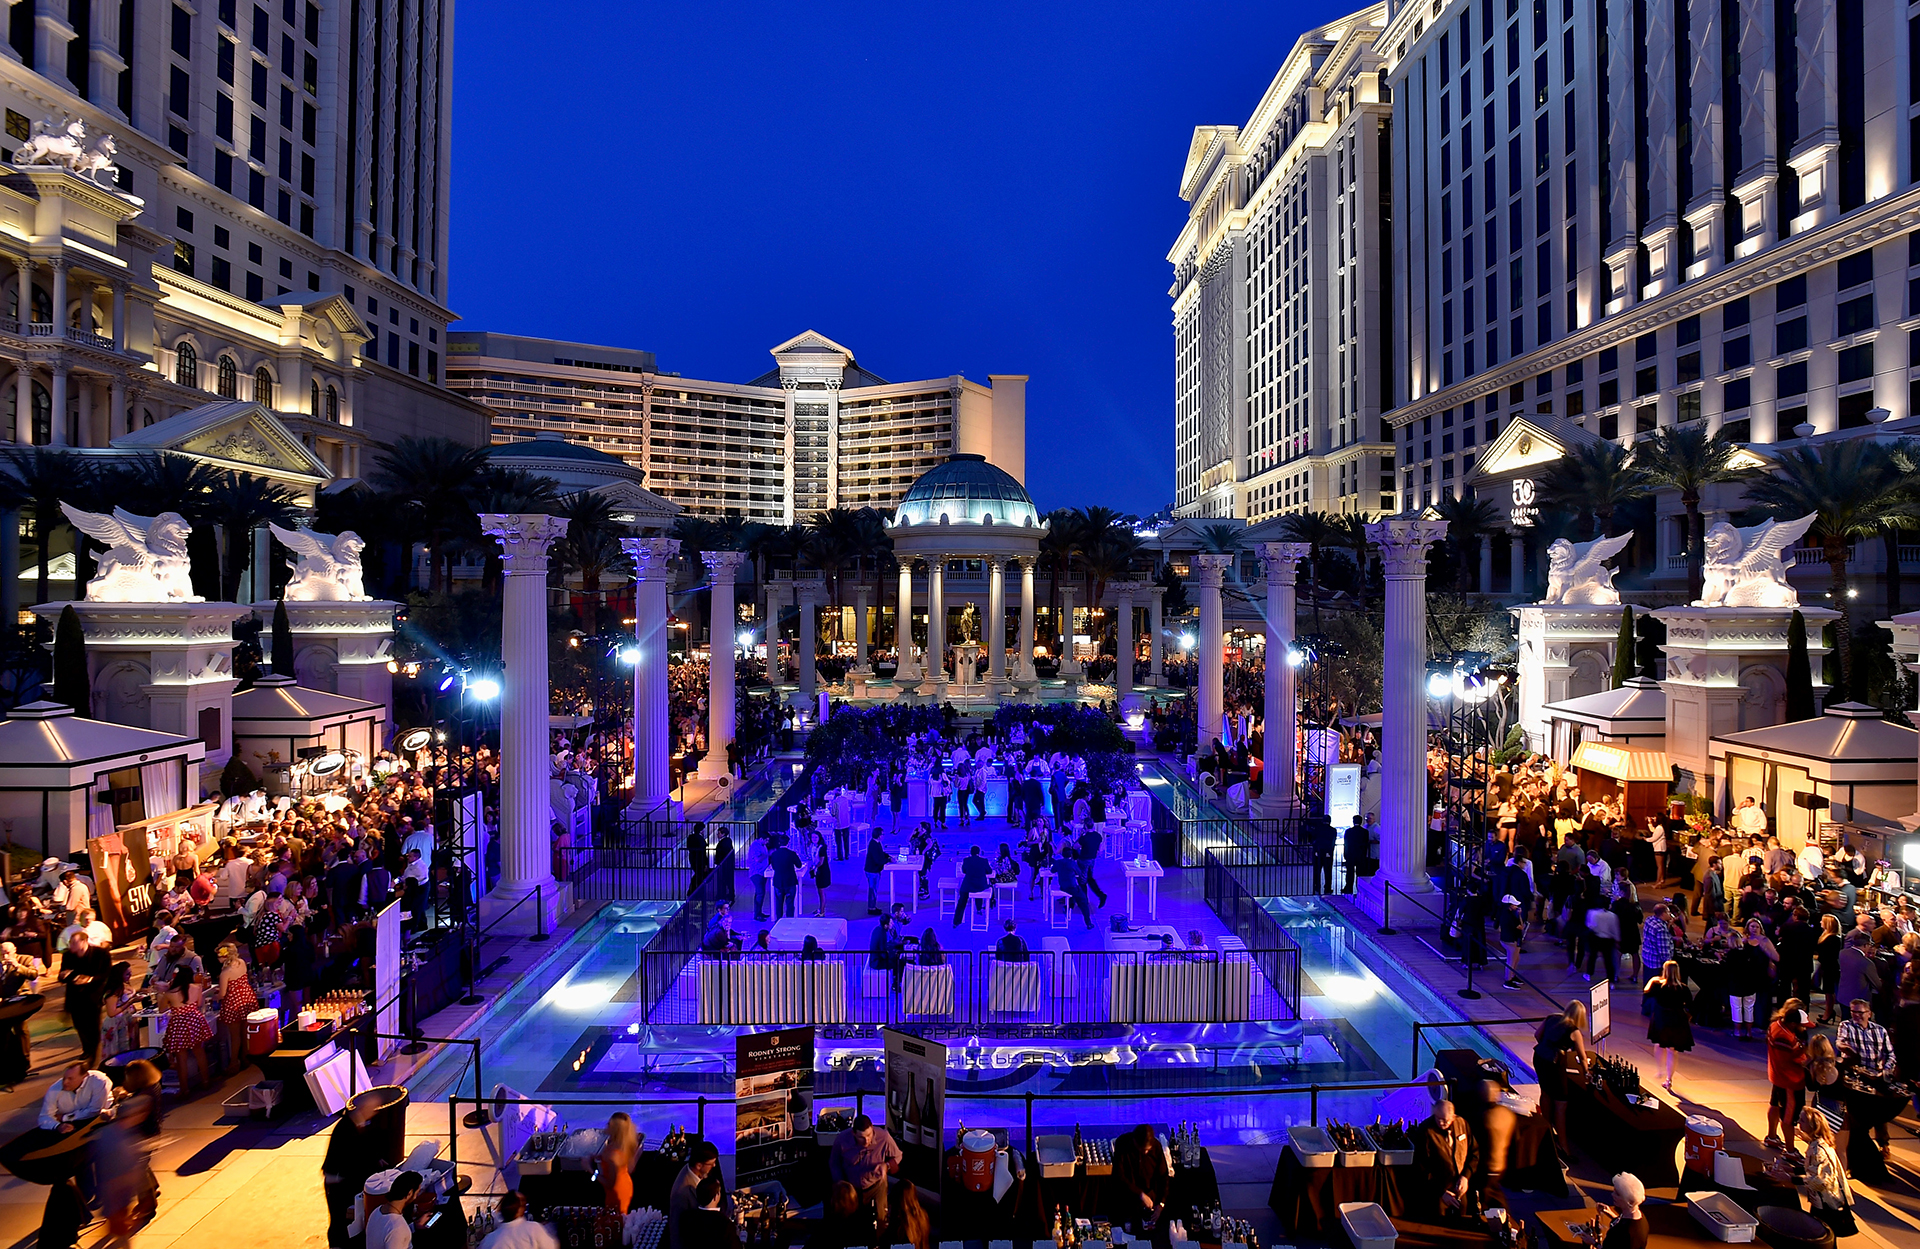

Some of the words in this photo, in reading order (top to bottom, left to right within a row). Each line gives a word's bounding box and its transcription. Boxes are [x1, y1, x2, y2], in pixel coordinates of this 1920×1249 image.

[1512, 478, 1536, 506] 50
[128, 883, 152, 913] STK
[823, 1028, 874, 1039] CHASE
[996, 1028, 1104, 1039] PREFERRED
[748, 1049, 774, 1057] RODNEY
[776, 1045, 801, 1053] STRONG
